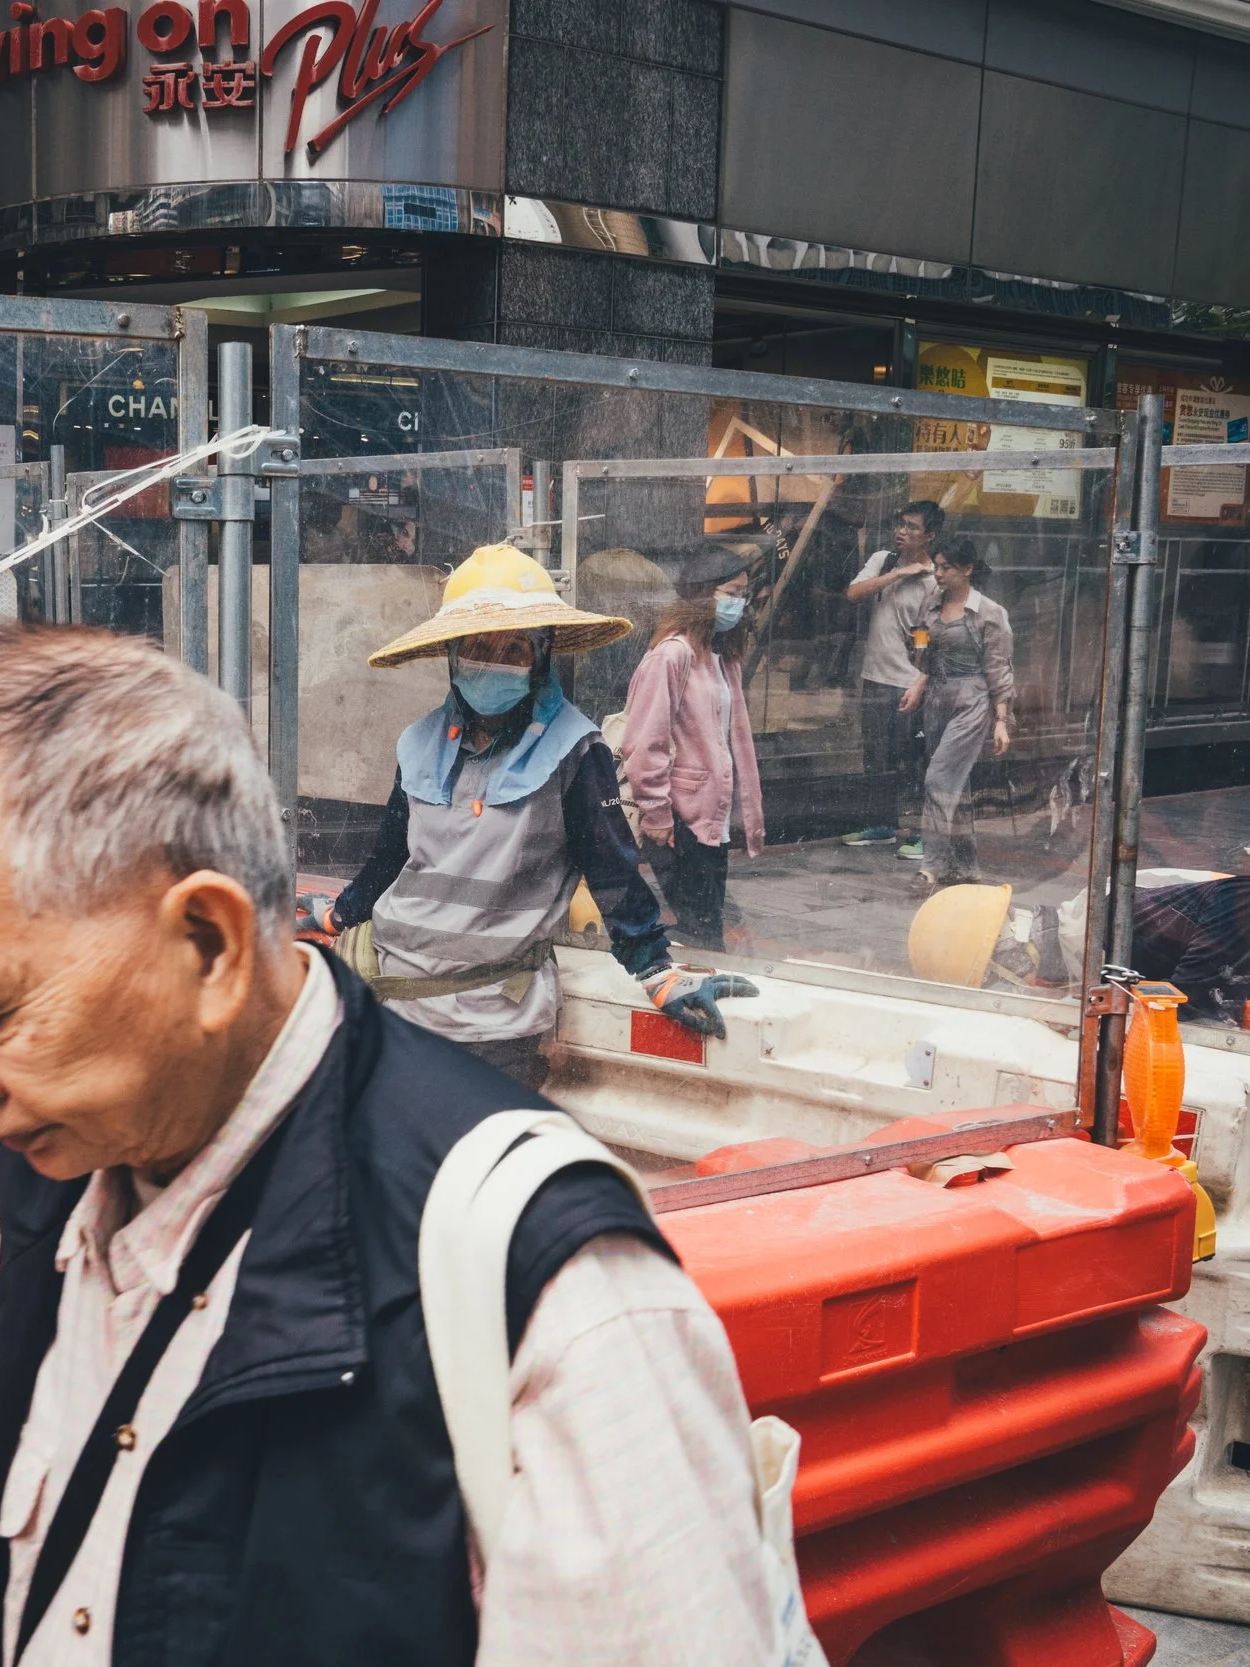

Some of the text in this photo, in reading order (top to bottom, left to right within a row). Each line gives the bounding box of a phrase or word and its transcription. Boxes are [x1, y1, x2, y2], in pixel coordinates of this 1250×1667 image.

[137, 0, 251, 52] on
[261, 0, 496, 153] Plus
[142, 60, 256, 112] 永安
[108, 394, 219, 420] CHANL
